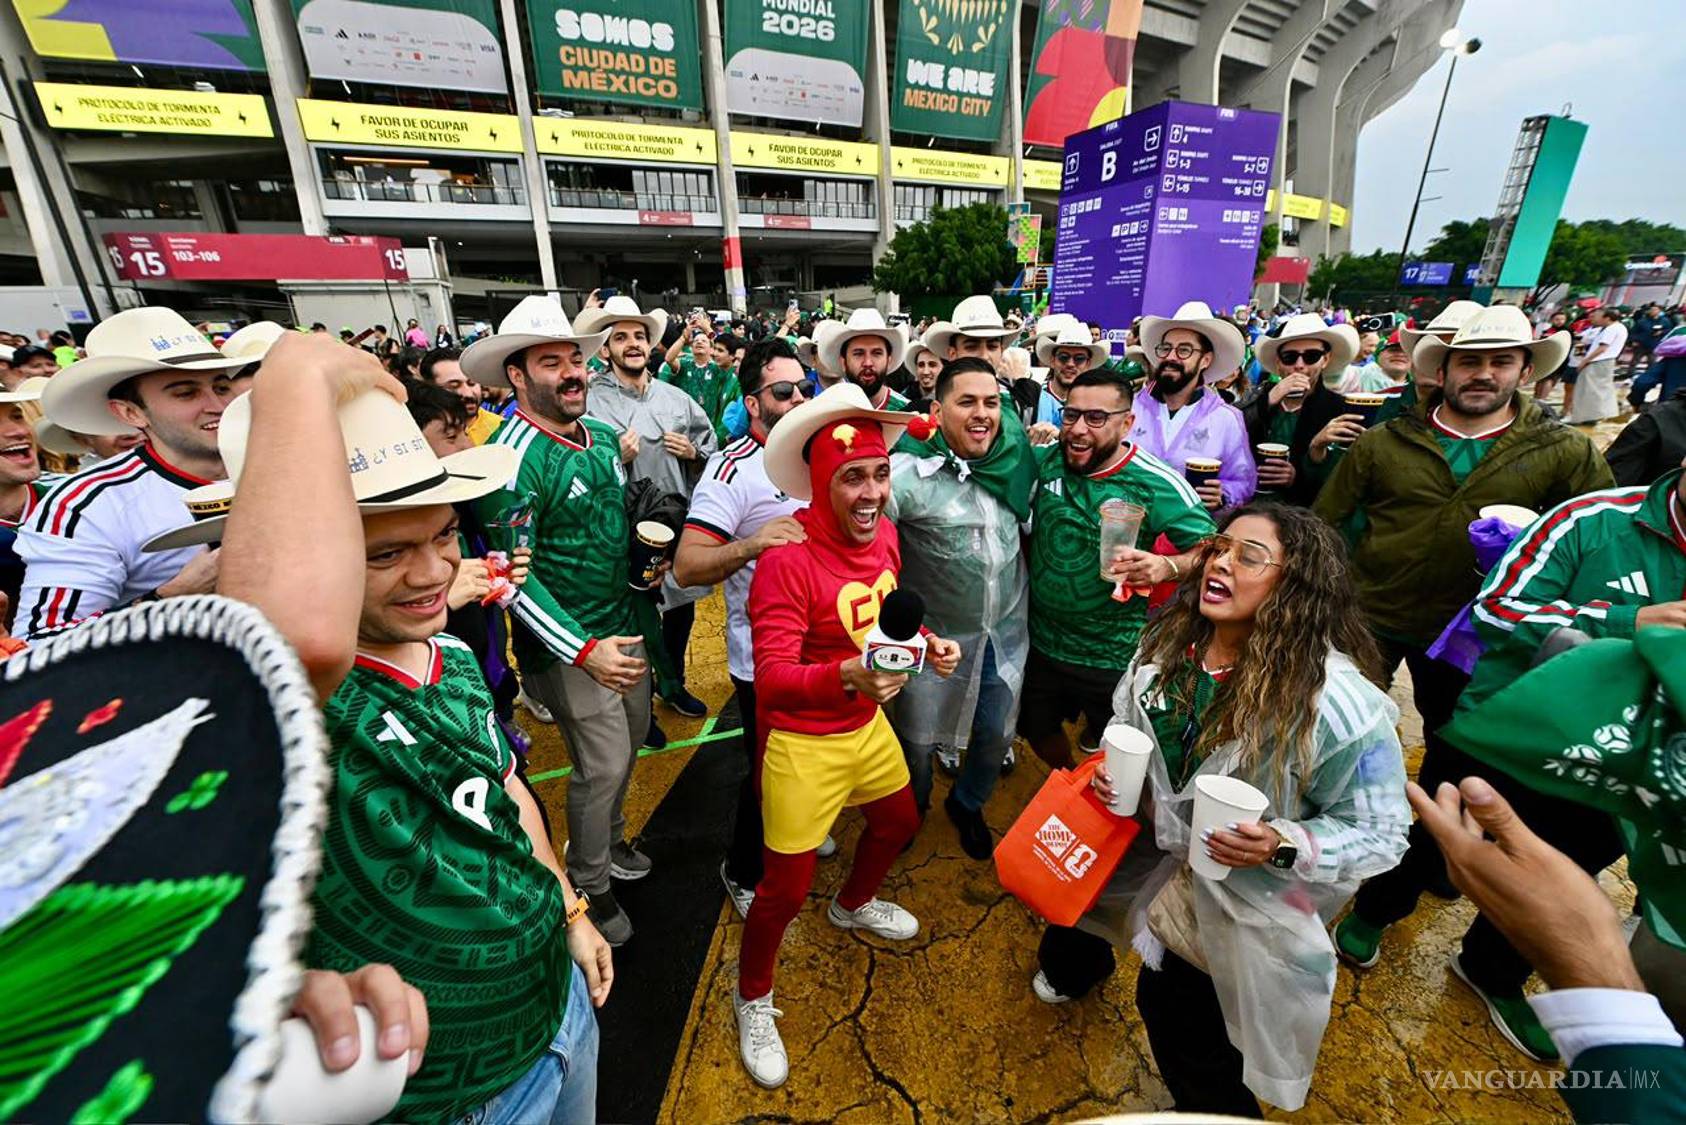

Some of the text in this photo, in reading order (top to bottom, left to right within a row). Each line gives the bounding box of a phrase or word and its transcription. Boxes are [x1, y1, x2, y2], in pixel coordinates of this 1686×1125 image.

[762, 0, 836, 18] MUNDIAL
[554, 9, 675, 52] SOMOS
[762, 11, 836, 42] 2026
[559, 45, 677, 77] CIUDAD DE
[562, 68, 678, 98] MÉXICO
[905, 58, 996, 97] WE ARE
[78, 97, 221, 115] PROTOCOLO DE TORMENTA
[904, 87, 992, 117] MEXICO CITY
[159, 116, 212, 128] ACTIVADO
[360, 114, 469, 132] FAVOR DE OCUPAR
[374, 128, 461, 143] SUS ASIENTOS
[572, 129, 624, 141] PROTOCOLO
[638, 134, 683, 145] TORMENTA
[634, 146, 674, 156] ACTIVADO
[768, 143, 843, 158] FAVOR DE OCUPAR
[777, 155, 836, 168] SUS ASIENTOS
[1101, 151, 1117, 182] B
[130, 251, 166, 276] 15
[172, 250, 221, 262] 103-106
[385, 249, 405, 270] 15
[1405, 267, 1419, 279] 17
[1039, 831, 1071, 841] HOME
